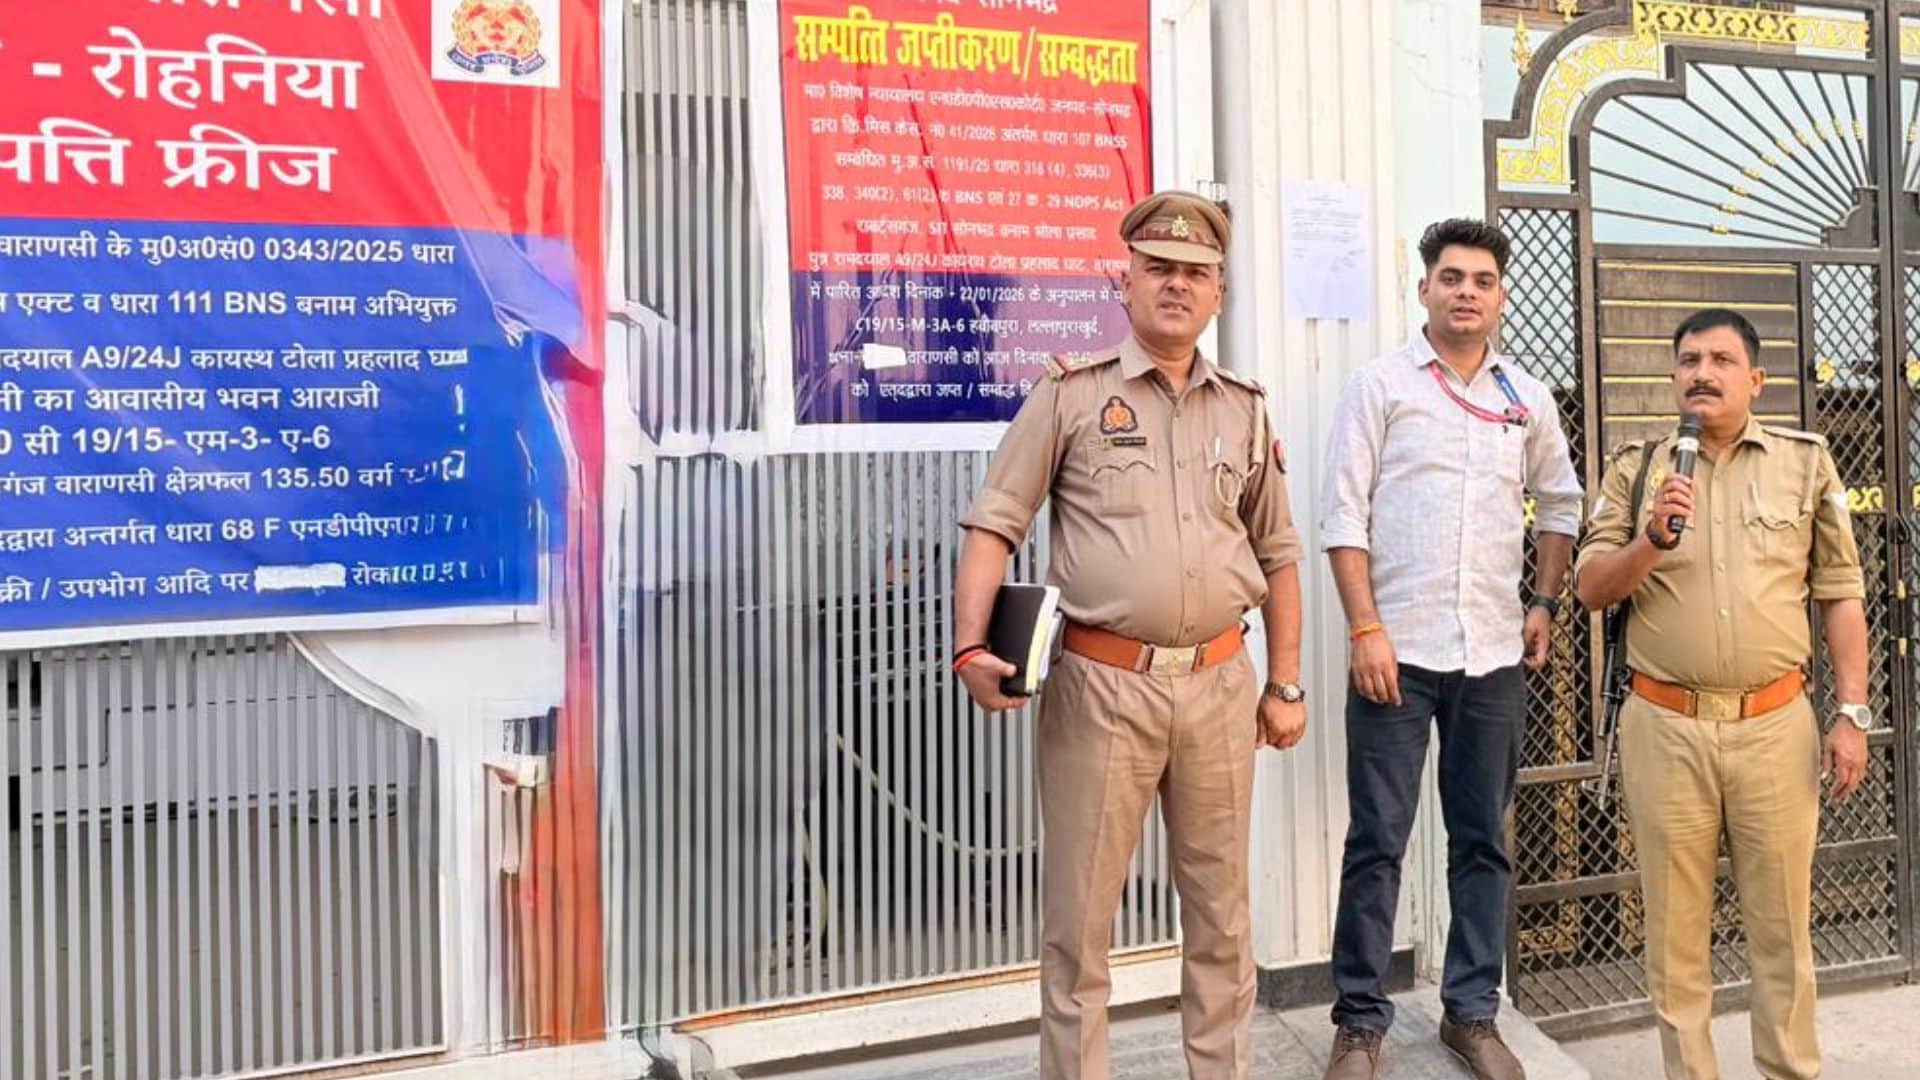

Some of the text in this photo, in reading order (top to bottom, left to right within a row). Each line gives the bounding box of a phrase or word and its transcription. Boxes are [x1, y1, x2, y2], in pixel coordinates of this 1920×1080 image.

[32, 27, 364, 110] - रोहनिया
[1094, 134, 1128, 149] BNSS
[157, 123, 338, 193] फ्रीज
[955, 190, 983, 205] BNS
[0, 230, 97, 258] वाराणसी
[106, 230, 131, 258] के
[264, 239, 403, 263] 0343/2025
[411, 243, 455, 264] धारा
[16, 292, 75, 316] एक्ट
[83, 293, 102, 312] व
[110, 293, 159, 314] धारा
[168, 290, 213, 313] 111
[224, 292, 287, 314] BNS
[295, 294, 356, 315] बनाम
[364, 289, 457, 322] अभियुक्त
[0, 348, 73, 372] दयाल
[81, 346, 181, 369] A9/24J
[191, 349, 274, 370] कायस्थ
[282, 342, 336, 370] टोला
[343, 349, 420, 373] प्रहलाद
[32, 388, 75, 411] का
[85, 380, 206, 411] आवासीय
[216, 387, 282, 410] भवन
[290, 380, 380, 409] आराजी
[22, 424, 61, 456] सी
[0, 471, 46, 496] गंज
[54, 467, 156, 494] वाराणसी
[165, 466, 250, 494] क्षेत्रफल
[260, 466, 350, 489] 135.50
[357, 462, 395, 487] वर्ग
[64, 519, 156, 547] अन्तर्गत
[165, 522, 213, 542] धारा
[221, 519, 255, 541] 68
[264, 518, 281, 539] F
[41, 577, 51, 600] /
[58, 571, 147, 599] उपभोग
[155, 569, 213, 595] आदि
[220, 572, 250, 592] पर
